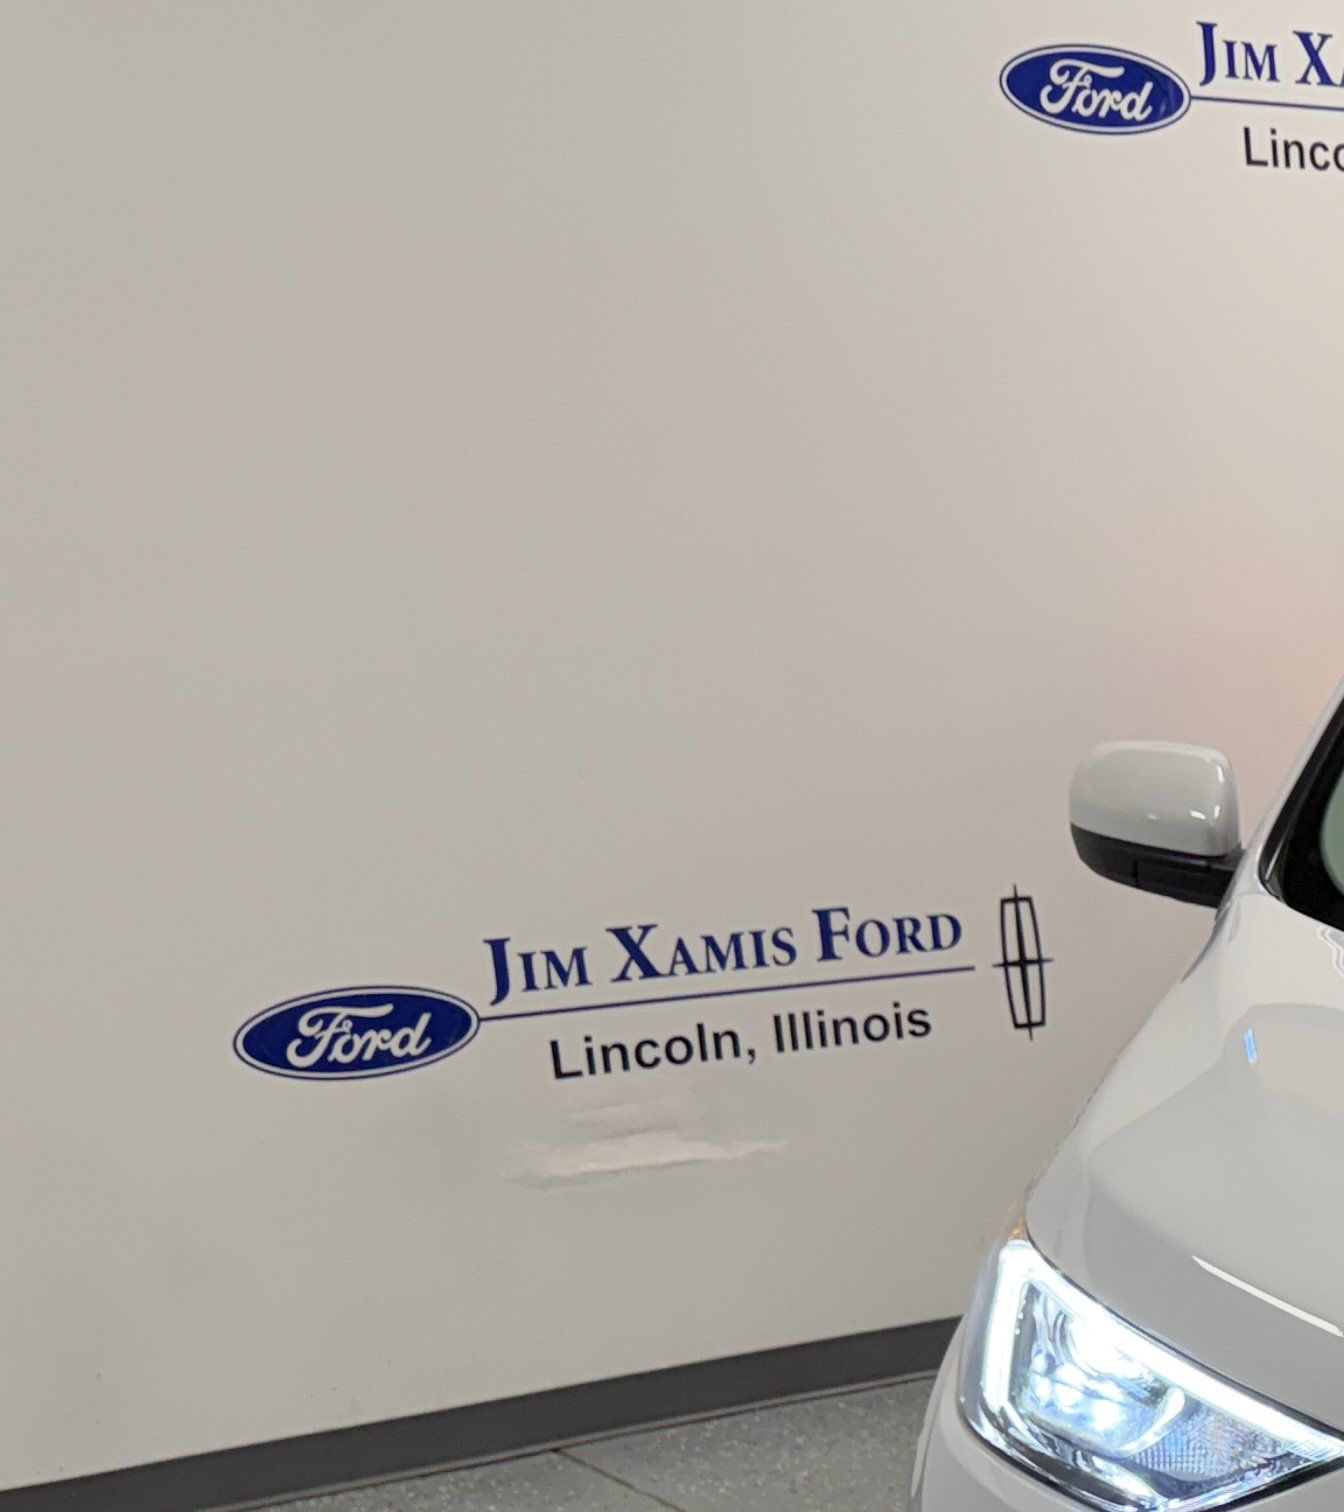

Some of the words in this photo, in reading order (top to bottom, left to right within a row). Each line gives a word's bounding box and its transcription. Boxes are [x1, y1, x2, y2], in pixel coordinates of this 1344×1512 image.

[1195, 21, 1279, 87] JIM
[1039, 58, 1153, 121] Ford
[483, 936, 591, 1006] JIM
[606, 922, 798, 984] XAMIS
[811, 906, 963, 964] FORD
[286, 1003, 431, 1068] Ford
[550, 1022, 758, 1081] Lincoln,
[774, 1002, 933, 1054] Illinois
